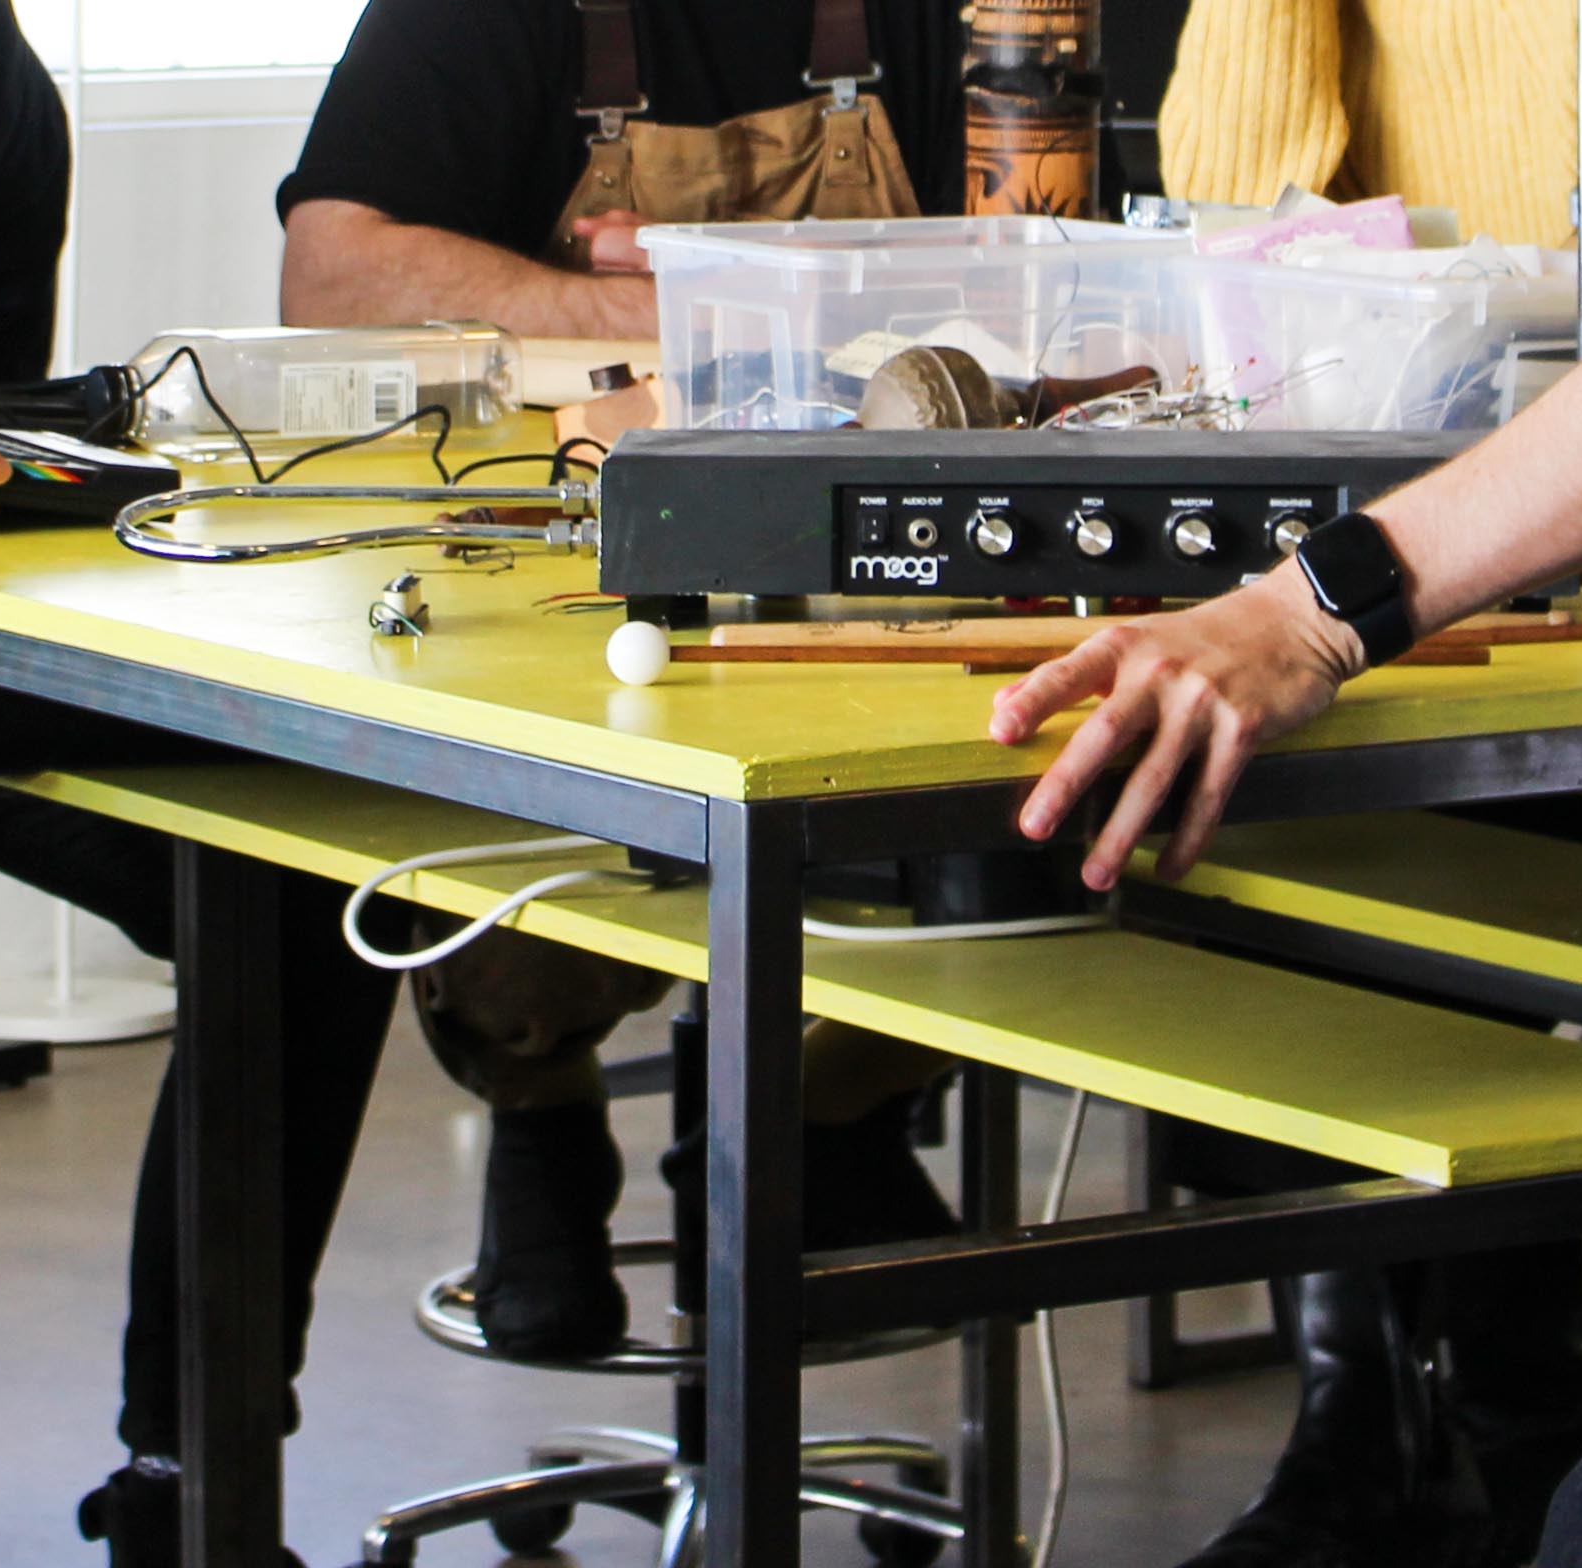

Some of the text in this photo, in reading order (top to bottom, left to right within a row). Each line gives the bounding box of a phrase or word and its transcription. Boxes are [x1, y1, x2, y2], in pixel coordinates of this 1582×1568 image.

[859, 496, 888, 506] POWER
[902, 496, 944, 507] AUDIO OUT
[978, 496, 1010, 506] VOLUME
[1081, 497, 1105, 506] PITCH
